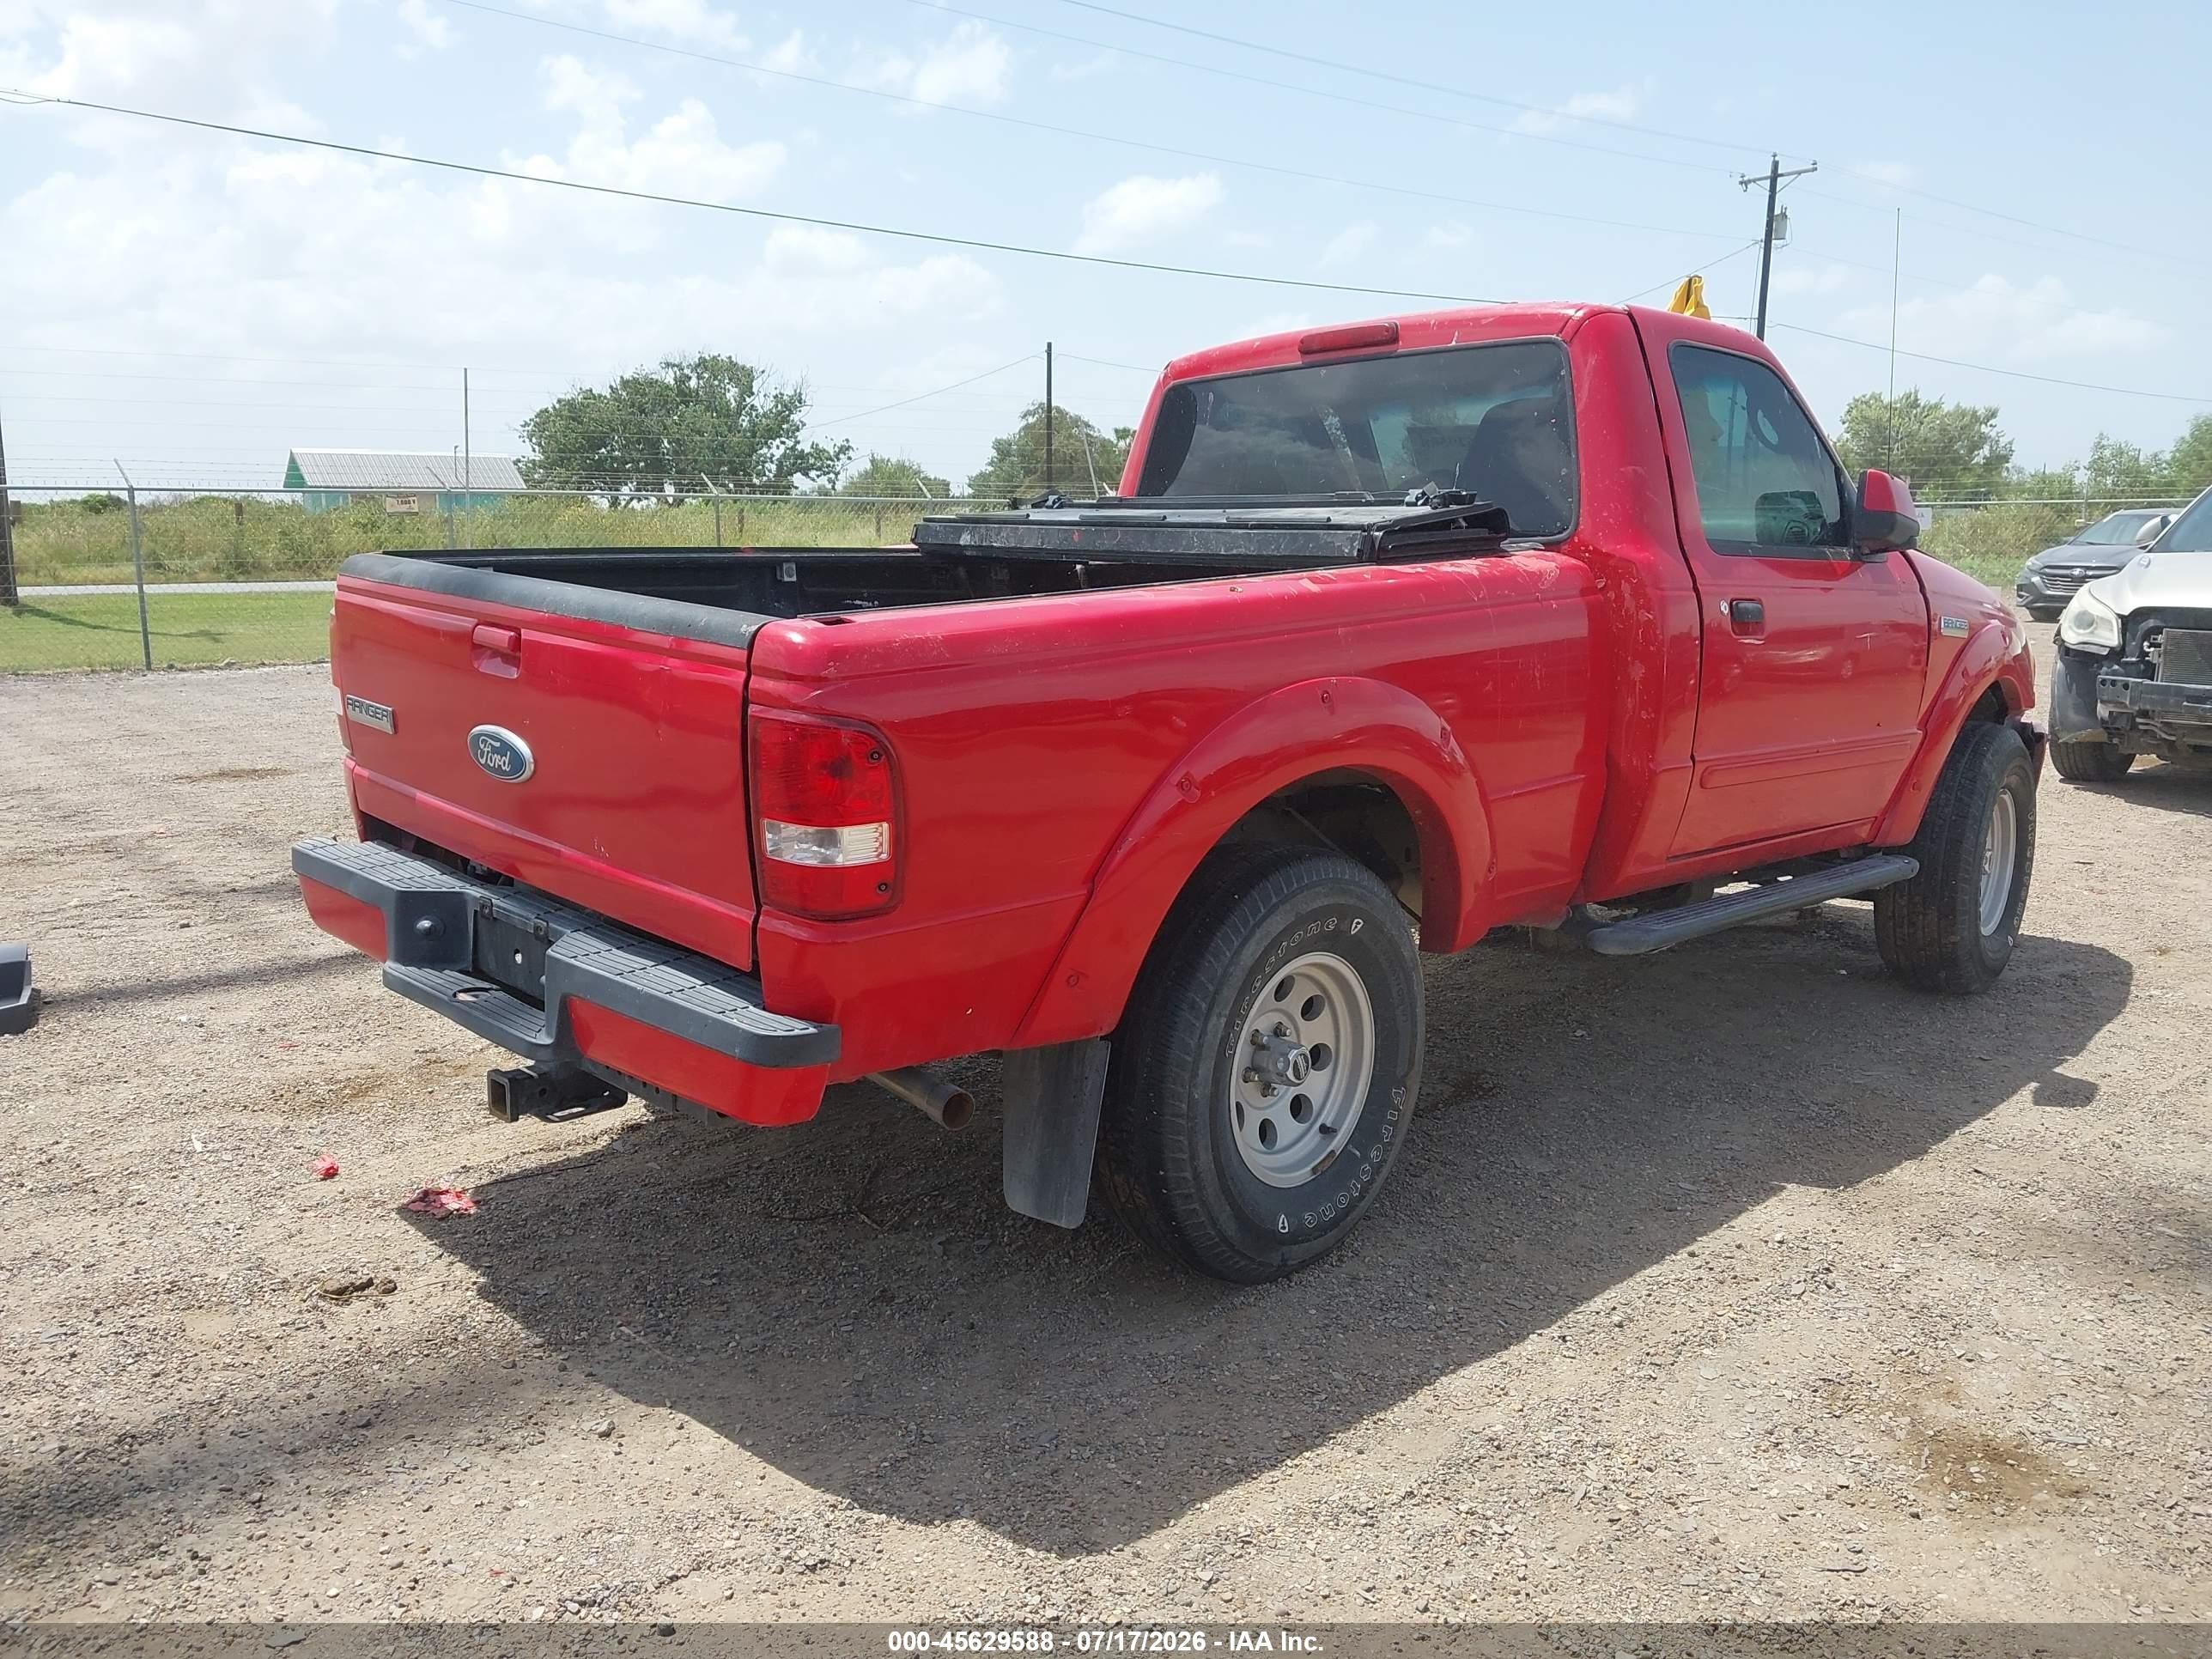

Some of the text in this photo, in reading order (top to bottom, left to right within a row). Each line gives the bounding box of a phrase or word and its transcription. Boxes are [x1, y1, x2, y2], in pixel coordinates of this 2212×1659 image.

[346, 697, 389, 722] RANGER
[477, 736, 511, 771] Ford
[1225, 917, 1338, 1058] Firestone
[1304, 1086, 1407, 1228] Firestone
